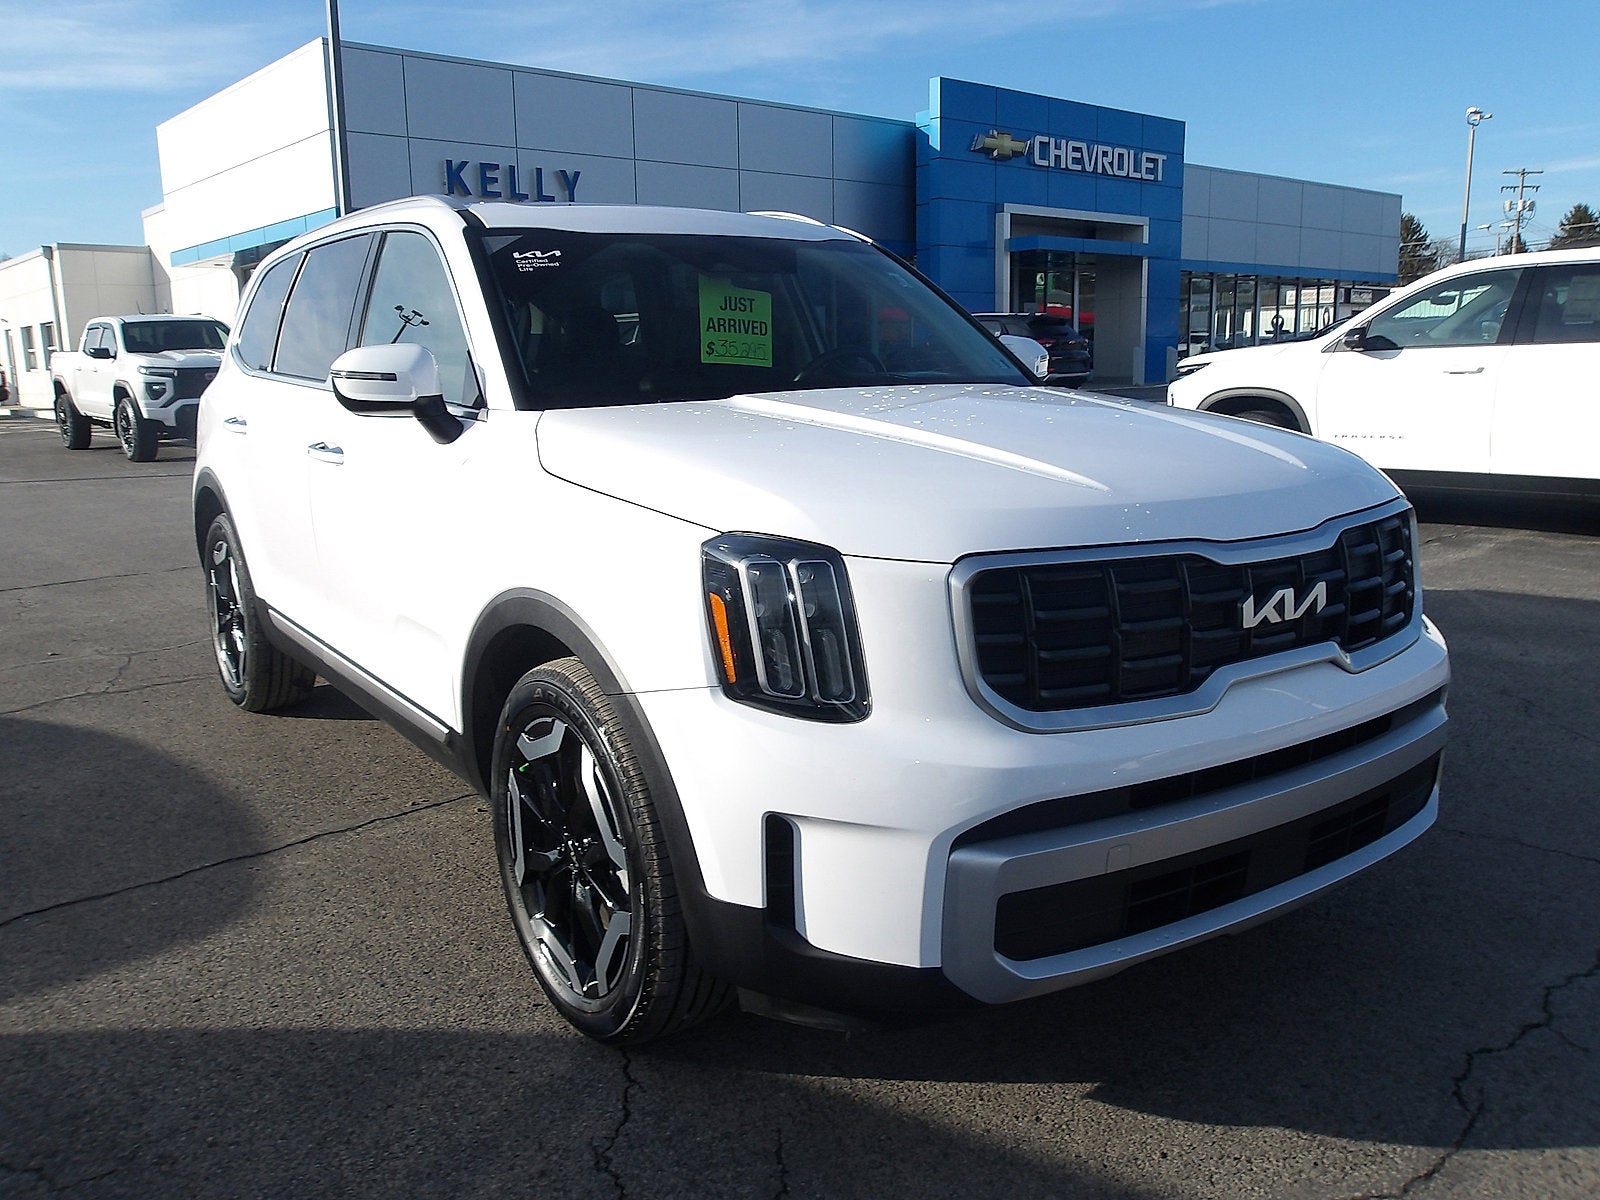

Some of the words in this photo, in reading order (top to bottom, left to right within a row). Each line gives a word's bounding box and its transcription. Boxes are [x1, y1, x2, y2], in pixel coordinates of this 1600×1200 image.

[1033, 135, 1167, 181] CHEVROLET
[444, 159, 581, 203] KELLY
[706, 316, 768, 336] ARRIVED
[719, 295, 756, 313] JUST
[1242, 581, 1327, 629] KIA
